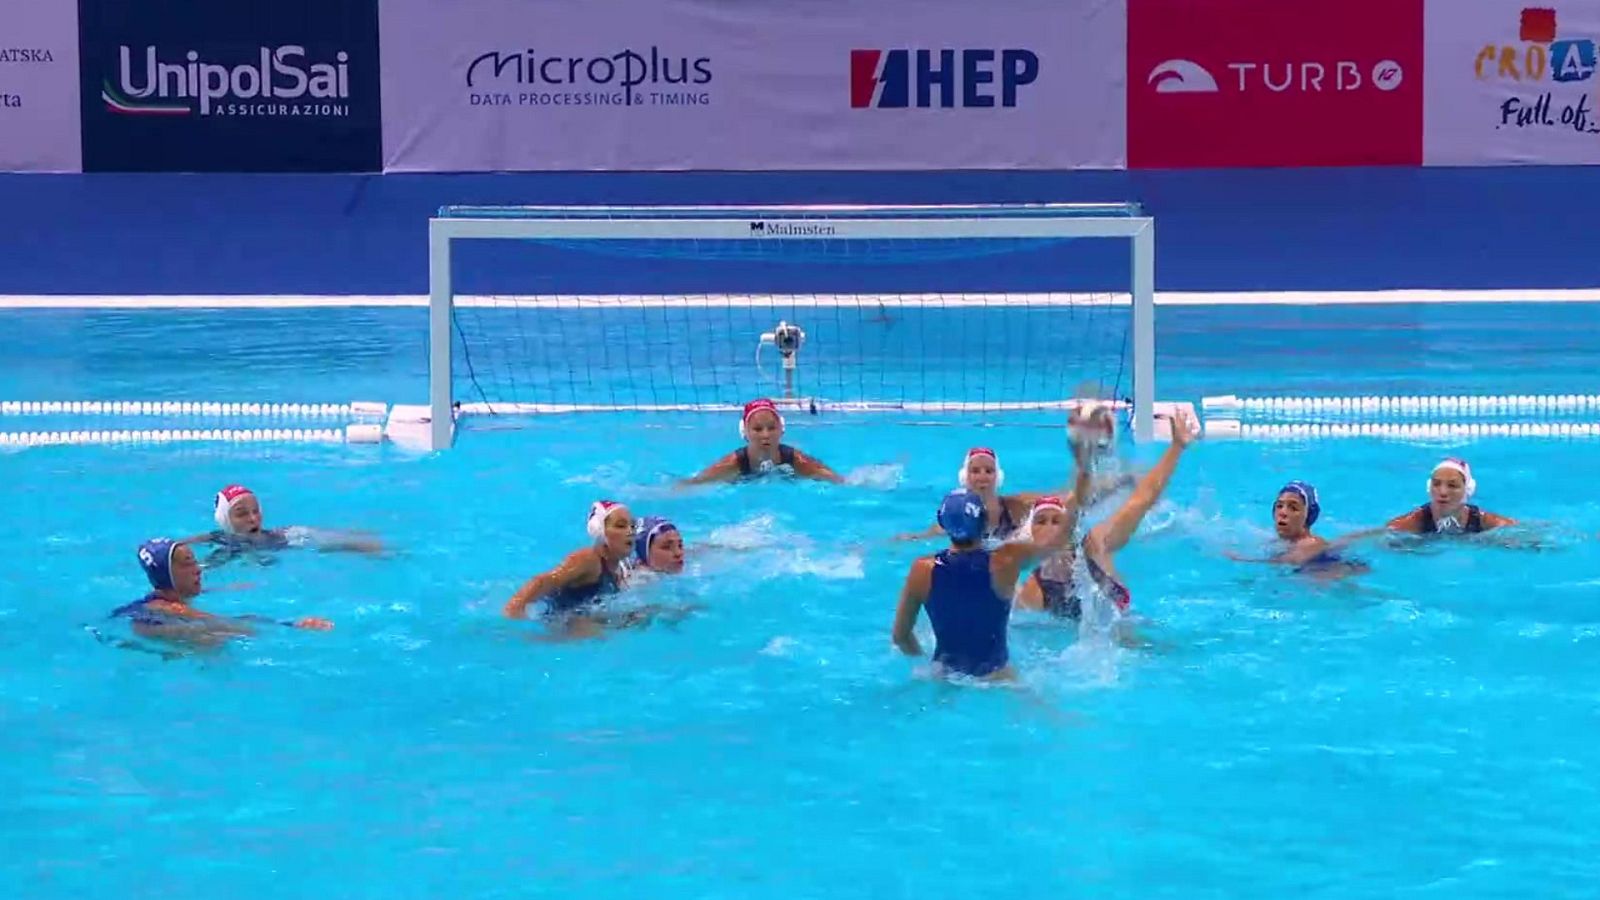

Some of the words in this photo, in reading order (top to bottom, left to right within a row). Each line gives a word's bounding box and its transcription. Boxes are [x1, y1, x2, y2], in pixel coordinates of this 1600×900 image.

[119, 45, 348, 115] UnipolSai
[466, 46, 712, 106] Microplus
[915, 49, 1039, 107] HEP
[216, 104, 348, 116] ASSICURAZIONI
[470, 93, 511, 105] DATA
[519, 93, 623, 105] PROCESSING
[634, 93, 644, 105] &
[650, 93, 710, 105] TIMING
[767, 223, 836, 235] Malmsten
